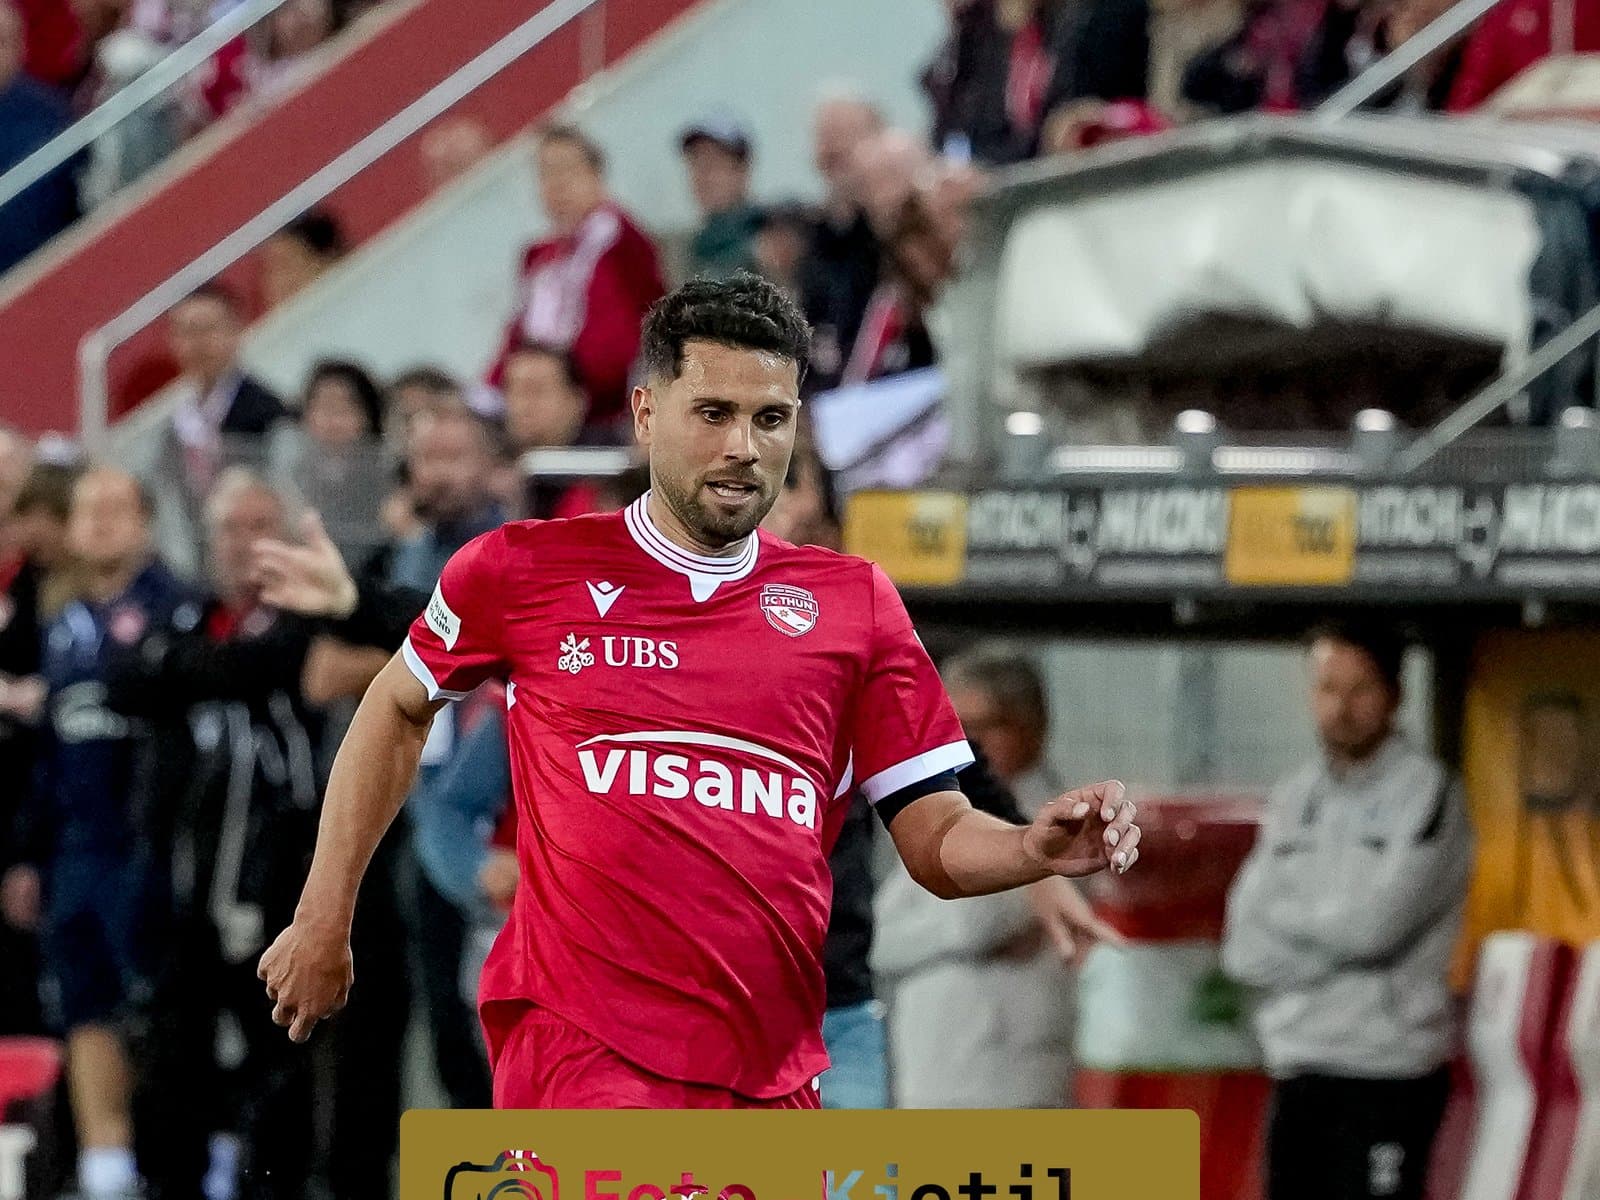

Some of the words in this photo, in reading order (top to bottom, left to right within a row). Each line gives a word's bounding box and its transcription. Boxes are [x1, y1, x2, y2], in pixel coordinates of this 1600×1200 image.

[764, 596, 778, 605] FC
[780, 596, 813, 611] THUN
[601, 636, 679, 669] UBS
